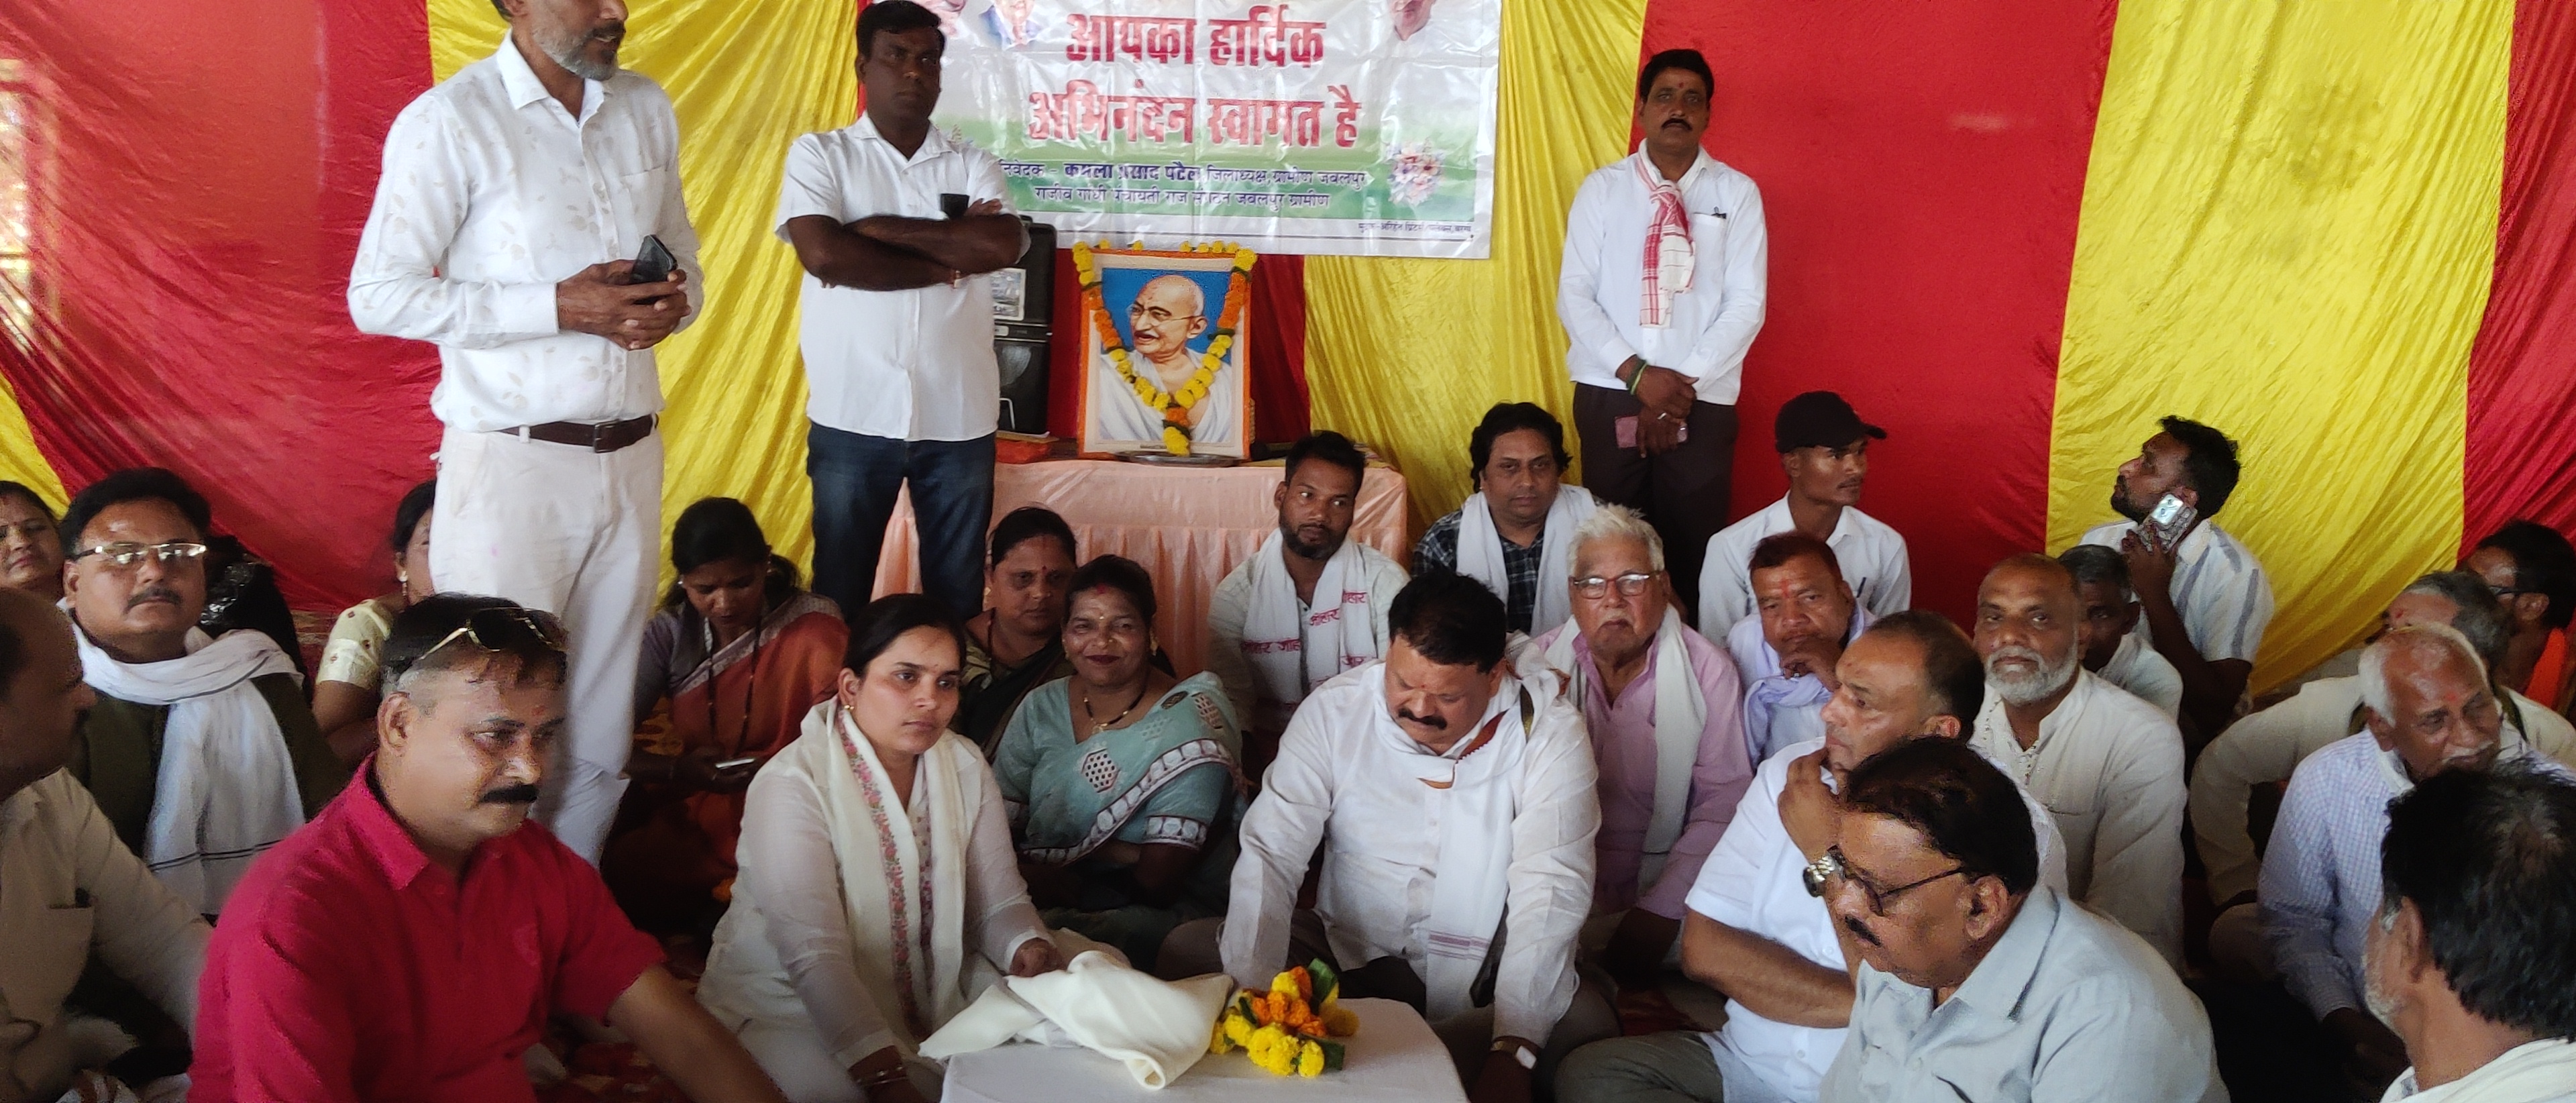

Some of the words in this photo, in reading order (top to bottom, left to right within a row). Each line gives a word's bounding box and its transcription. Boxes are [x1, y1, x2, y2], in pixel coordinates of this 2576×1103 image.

[1066, 13, 1197, 64] आपका
[1208, 4, 1327, 67] हार्दिक
[1028, 78, 1196, 143] अभिनंदन
[1207, 97, 1325, 146] स्वागत
[1328, 85, 1362, 148] है
[1063, 163, 1113, 179] कमला
[1035, 183, 1073, 200] राजीव
[1112, 185, 1161, 202] पंचायती
[1165, 191, 1188, 203] राज
[1288, 190, 1330, 207] ग्रामीण
